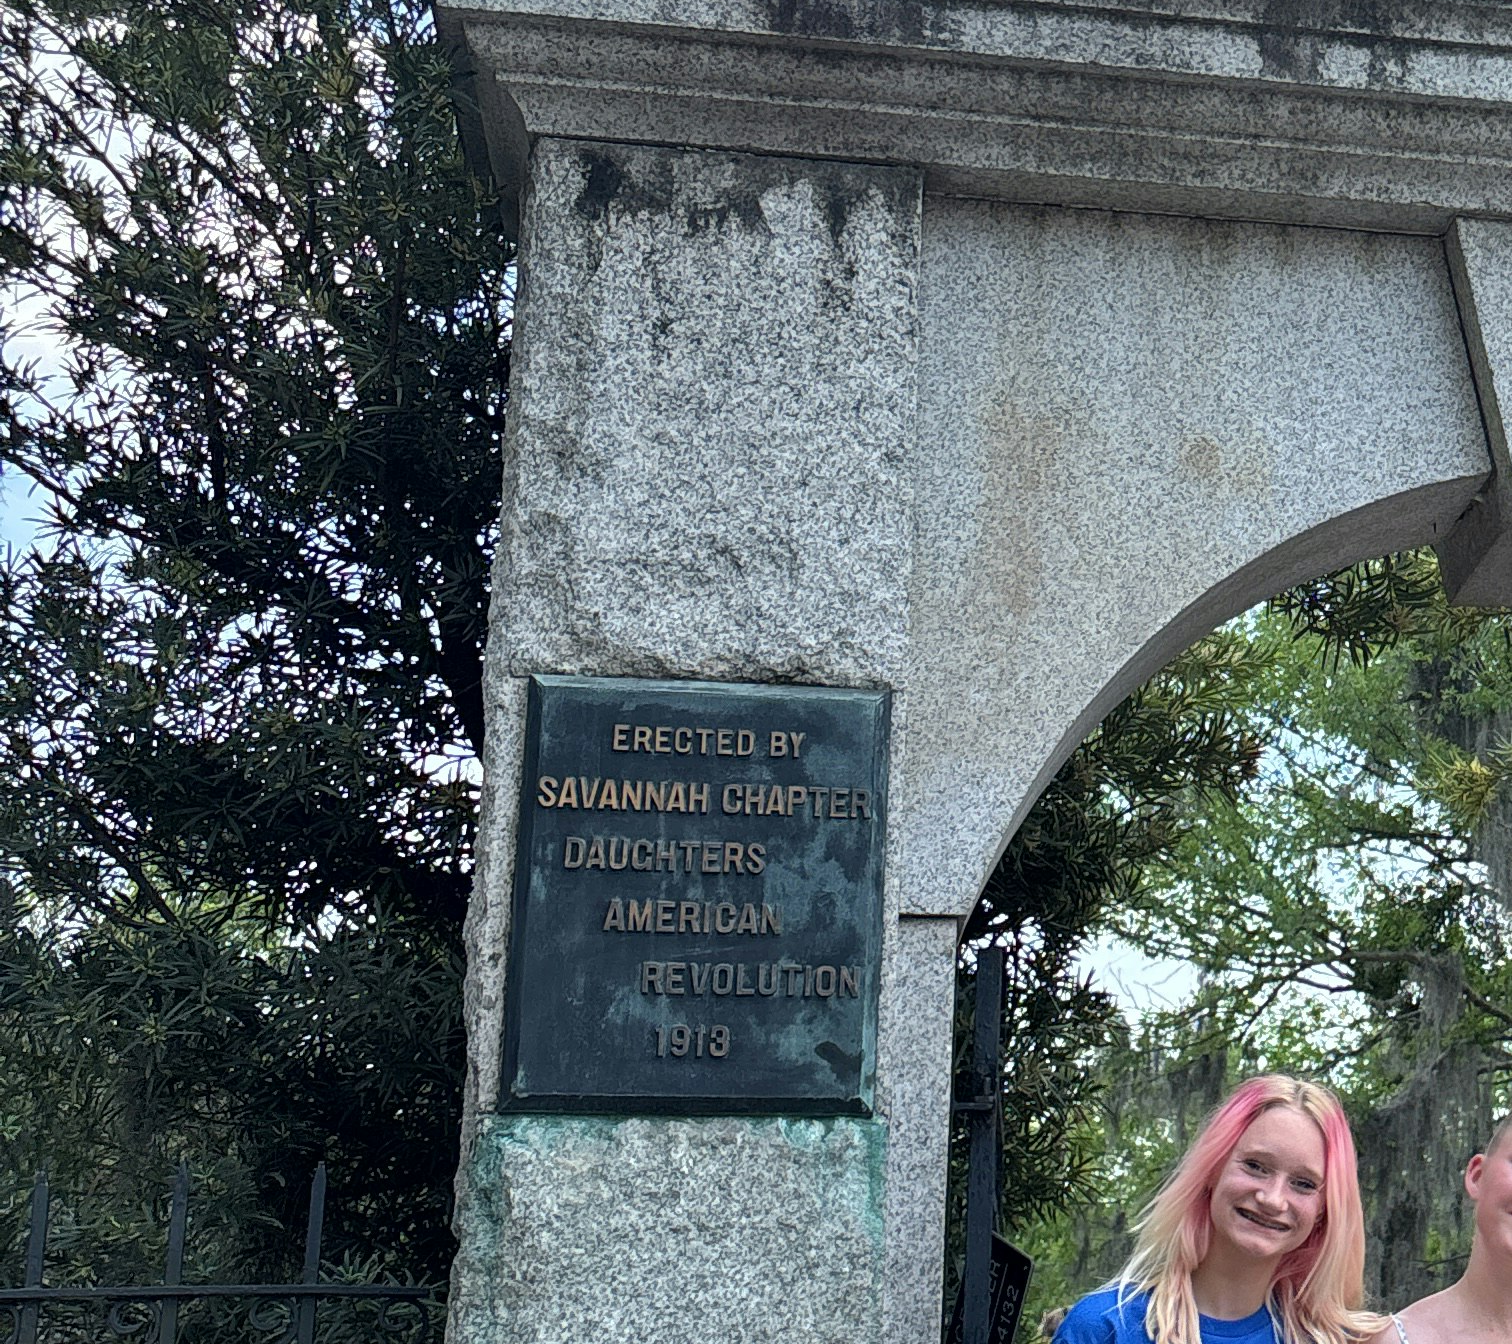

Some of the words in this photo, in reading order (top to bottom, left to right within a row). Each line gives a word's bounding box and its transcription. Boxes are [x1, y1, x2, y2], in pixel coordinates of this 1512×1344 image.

[612, 723, 755, 757] ERECTED
[770, 730, 806, 759] BY
[537, 776, 709, 814] SAVANNAH
[722, 783, 873, 819] CHAPTER
[563, 836, 768, 875] DAUGHTERS
[603, 898, 782, 937] AMERICAN
[640, 961, 862, 999] REVOLUTION
[655, 1024, 731, 1058] 1913
